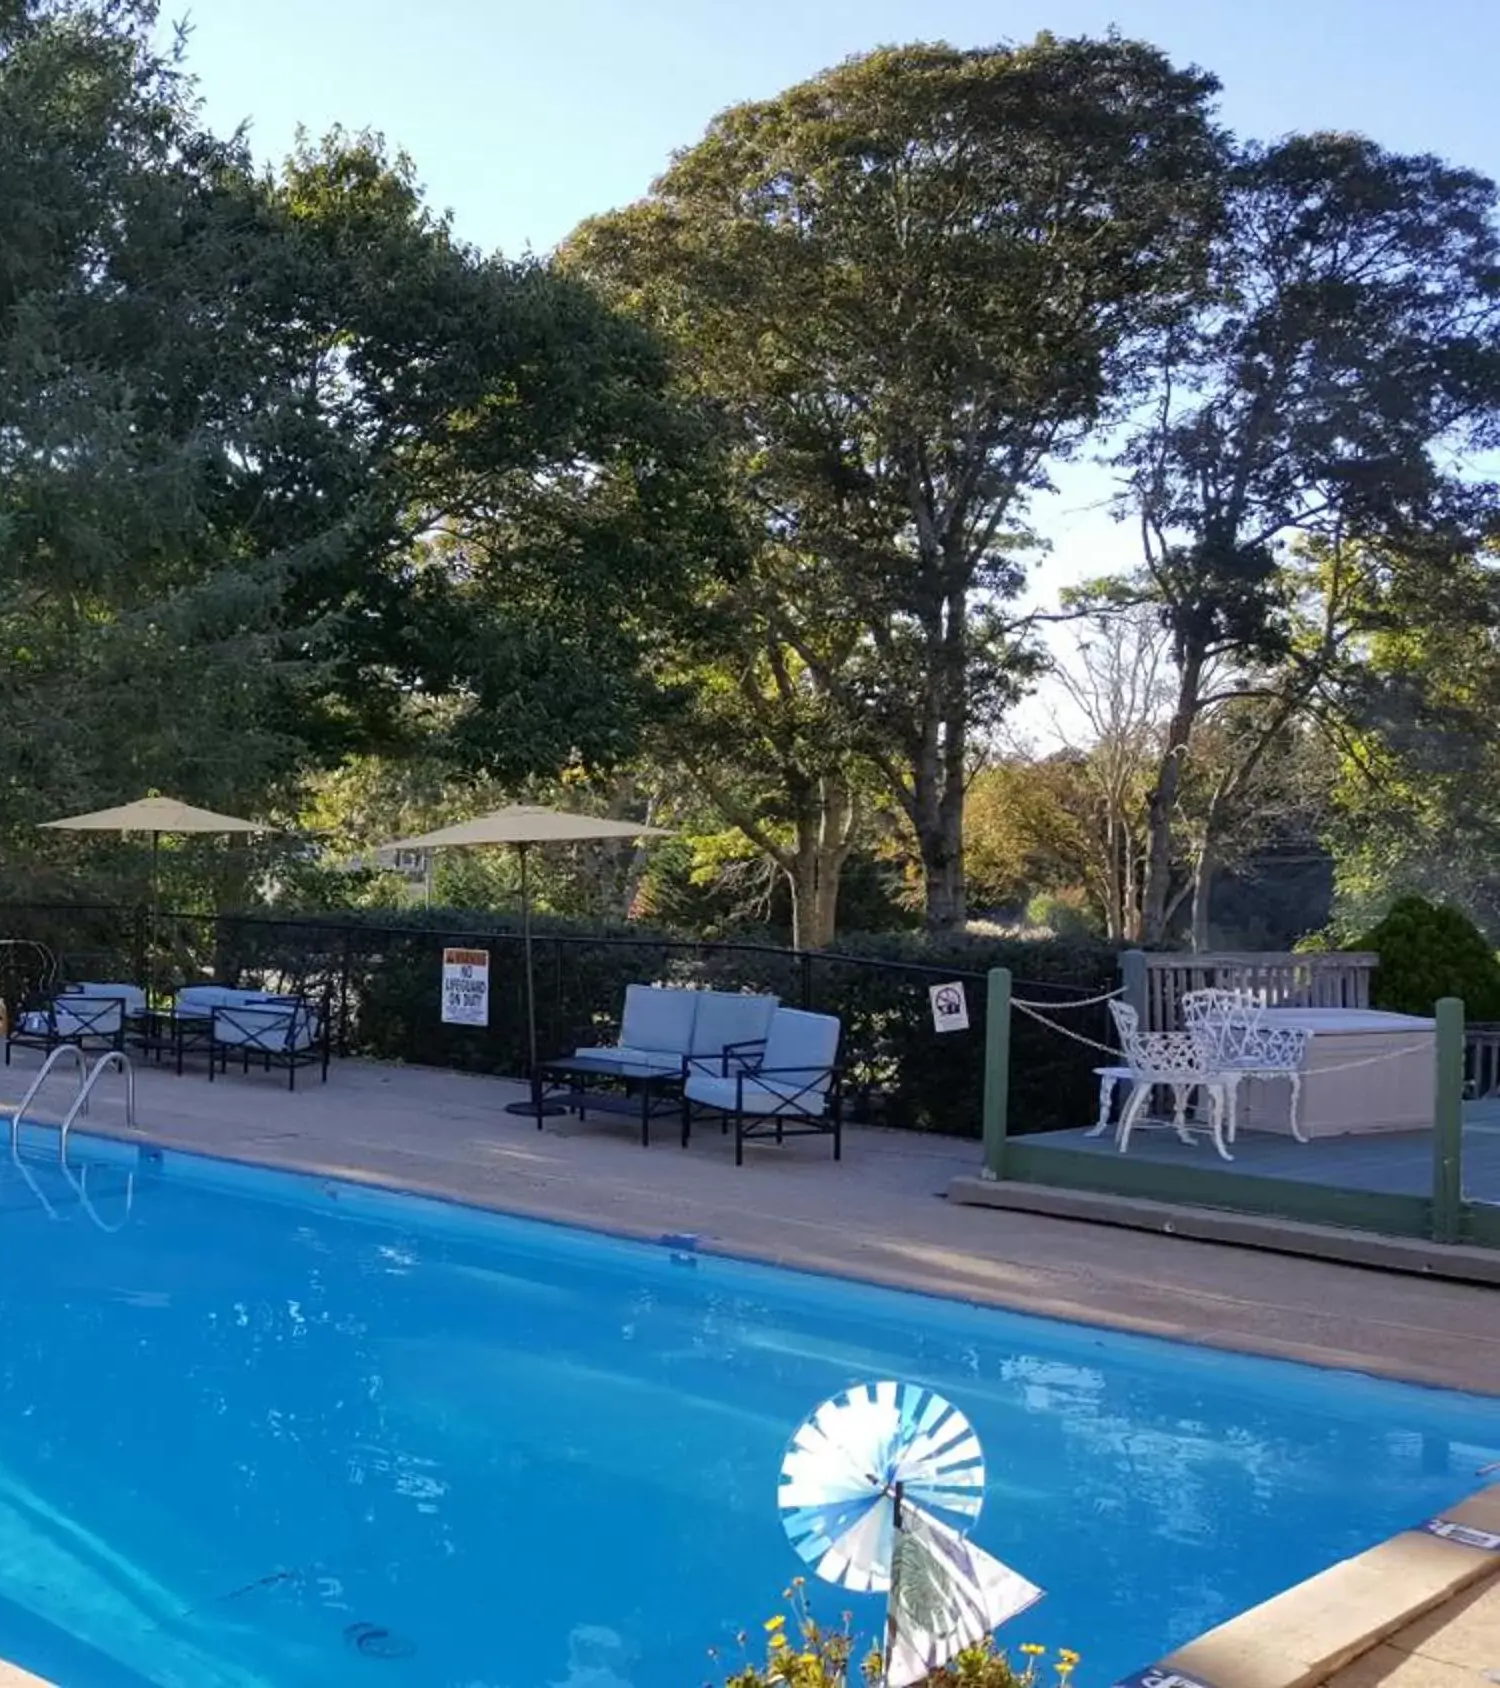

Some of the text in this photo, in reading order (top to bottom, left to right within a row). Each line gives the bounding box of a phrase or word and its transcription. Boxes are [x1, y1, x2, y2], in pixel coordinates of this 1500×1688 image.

[461, 966, 473, 978] NO
[446, 978, 486, 994] LIFEGUARD
[449, 992, 482, 1007] ON DUTY
